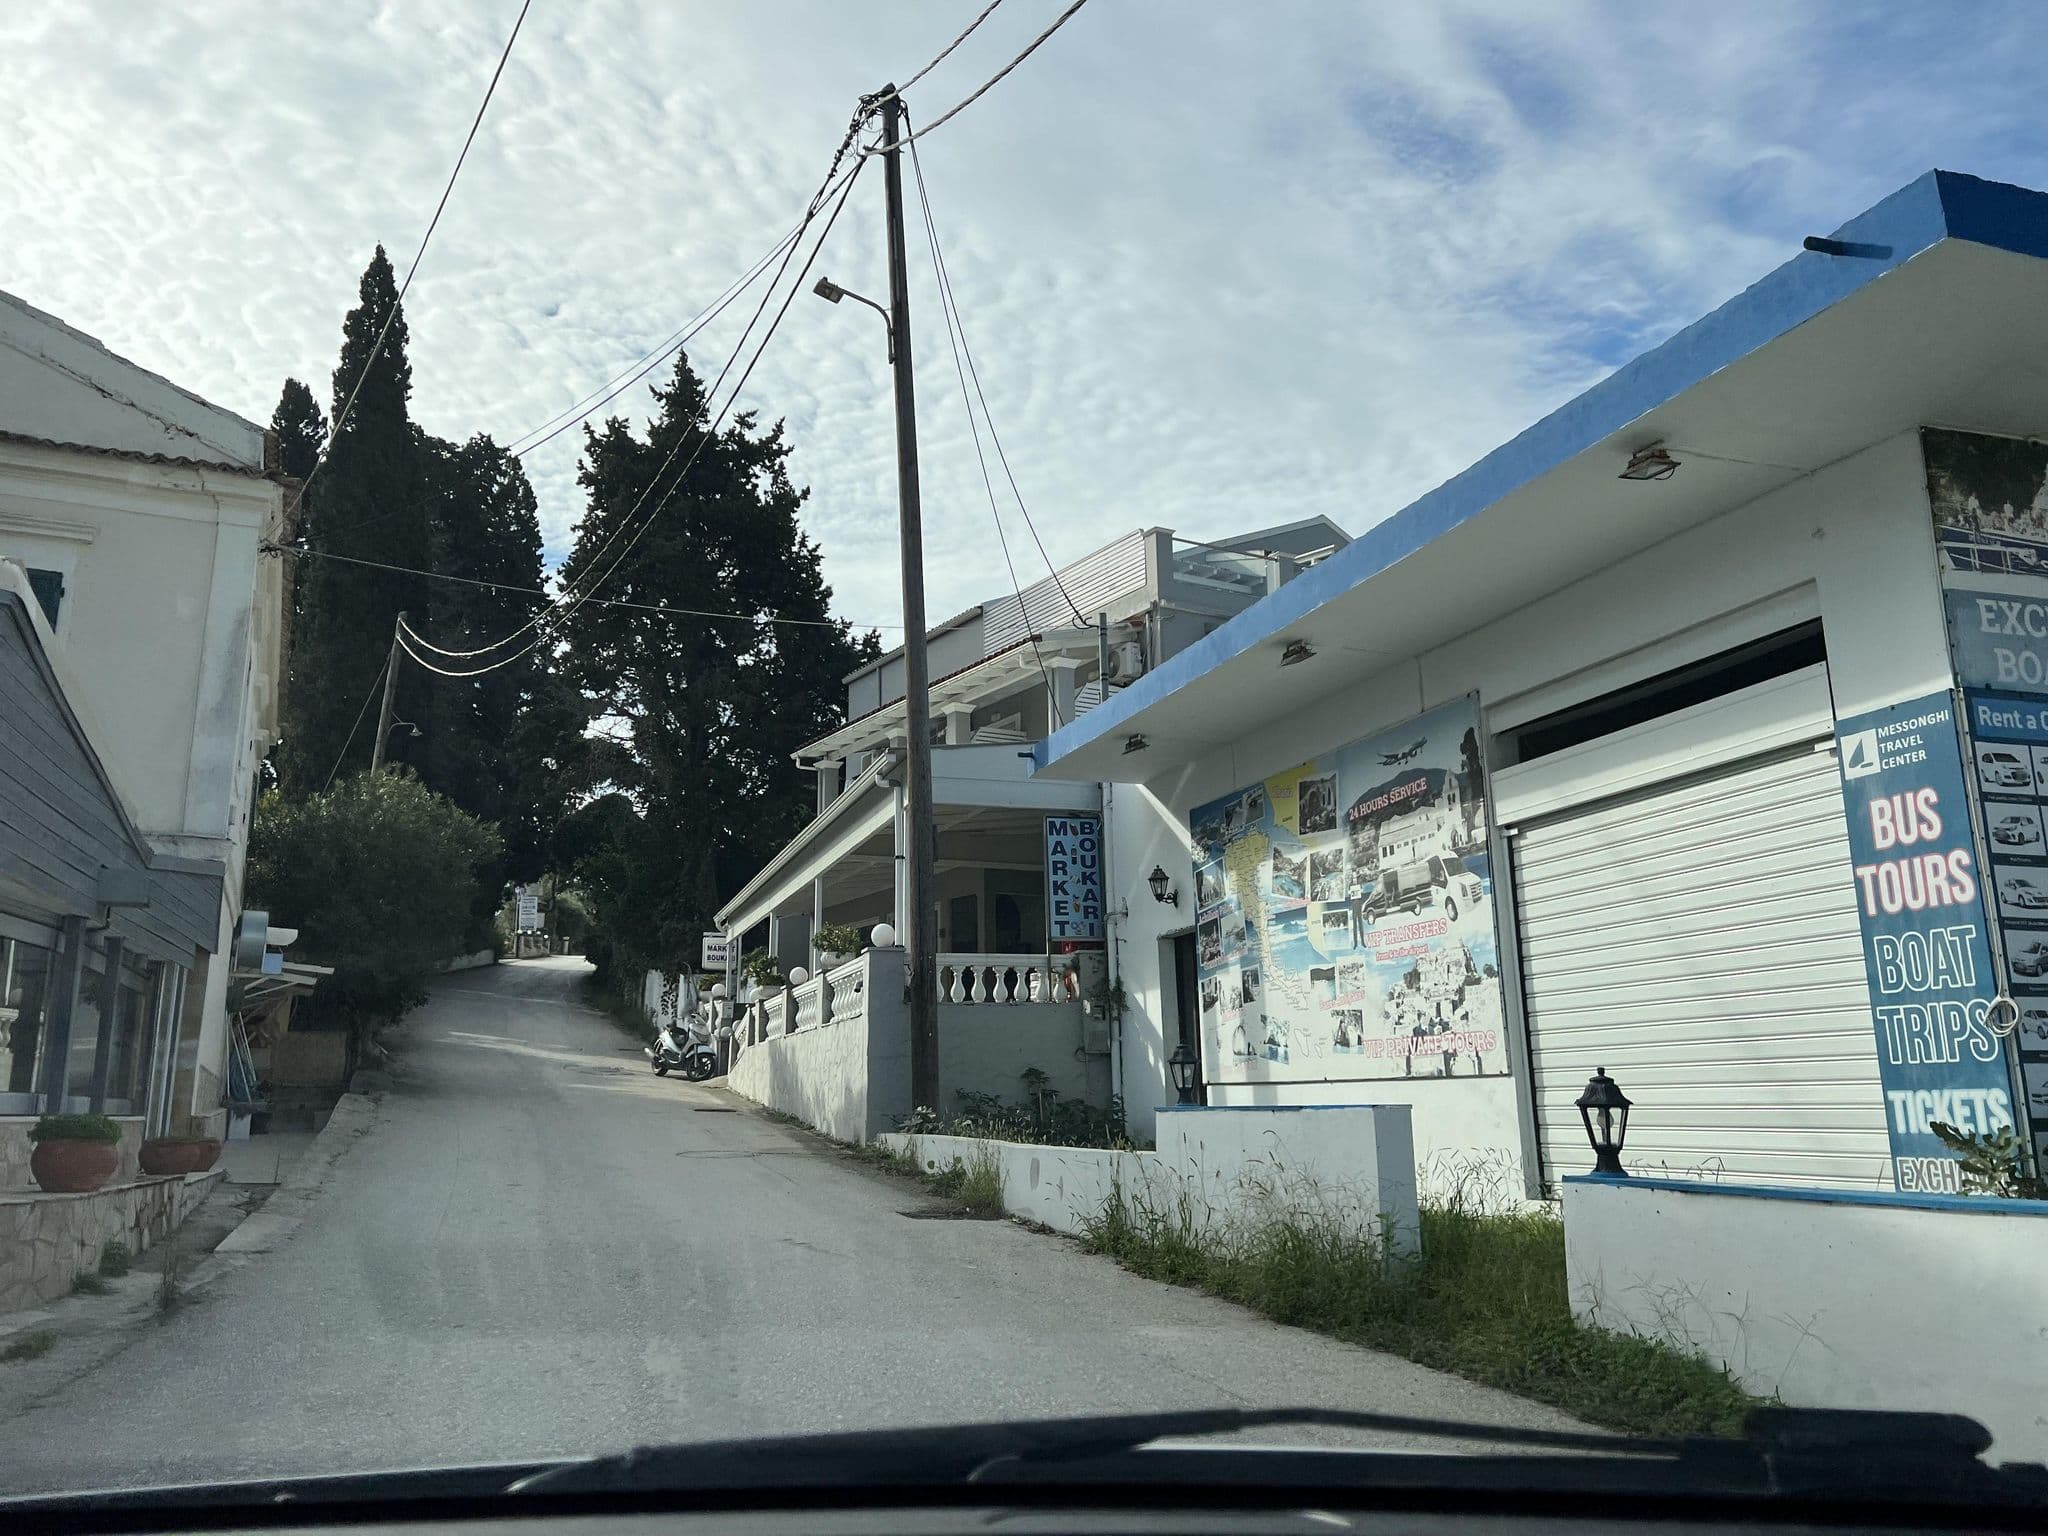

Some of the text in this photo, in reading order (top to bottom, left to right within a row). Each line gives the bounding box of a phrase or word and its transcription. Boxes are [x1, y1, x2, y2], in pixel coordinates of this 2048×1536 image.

[1976, 598, 2048, 638] EXC
[1878, 709, 1949, 738] MESSONGHI
[1978, 705, 2022, 729] Rent
[2026, 714, 2037, 730] a
[1879, 734, 1924, 754] TRAVEL
[1882, 749, 1927, 770] CENTER
[1349, 777, 1427, 821] 24 HOURS SERVICE
[1869, 787, 1943, 851] BUS
[1048, 820, 1070, 937] MARKET
[1078, 820, 1099, 937] BOUKARI
[1855, 847, 1977, 917] TOURS
[1365, 918, 1447, 948] VIP TRANSFERS
[1873, 924, 1977, 994] BOAT
[1363, 1029, 1497, 1058] VIP PRIVATE TOURS
[1876, 997, 1999, 1065] TRIPS
[1887, 1087, 2013, 1135] TICKETS
